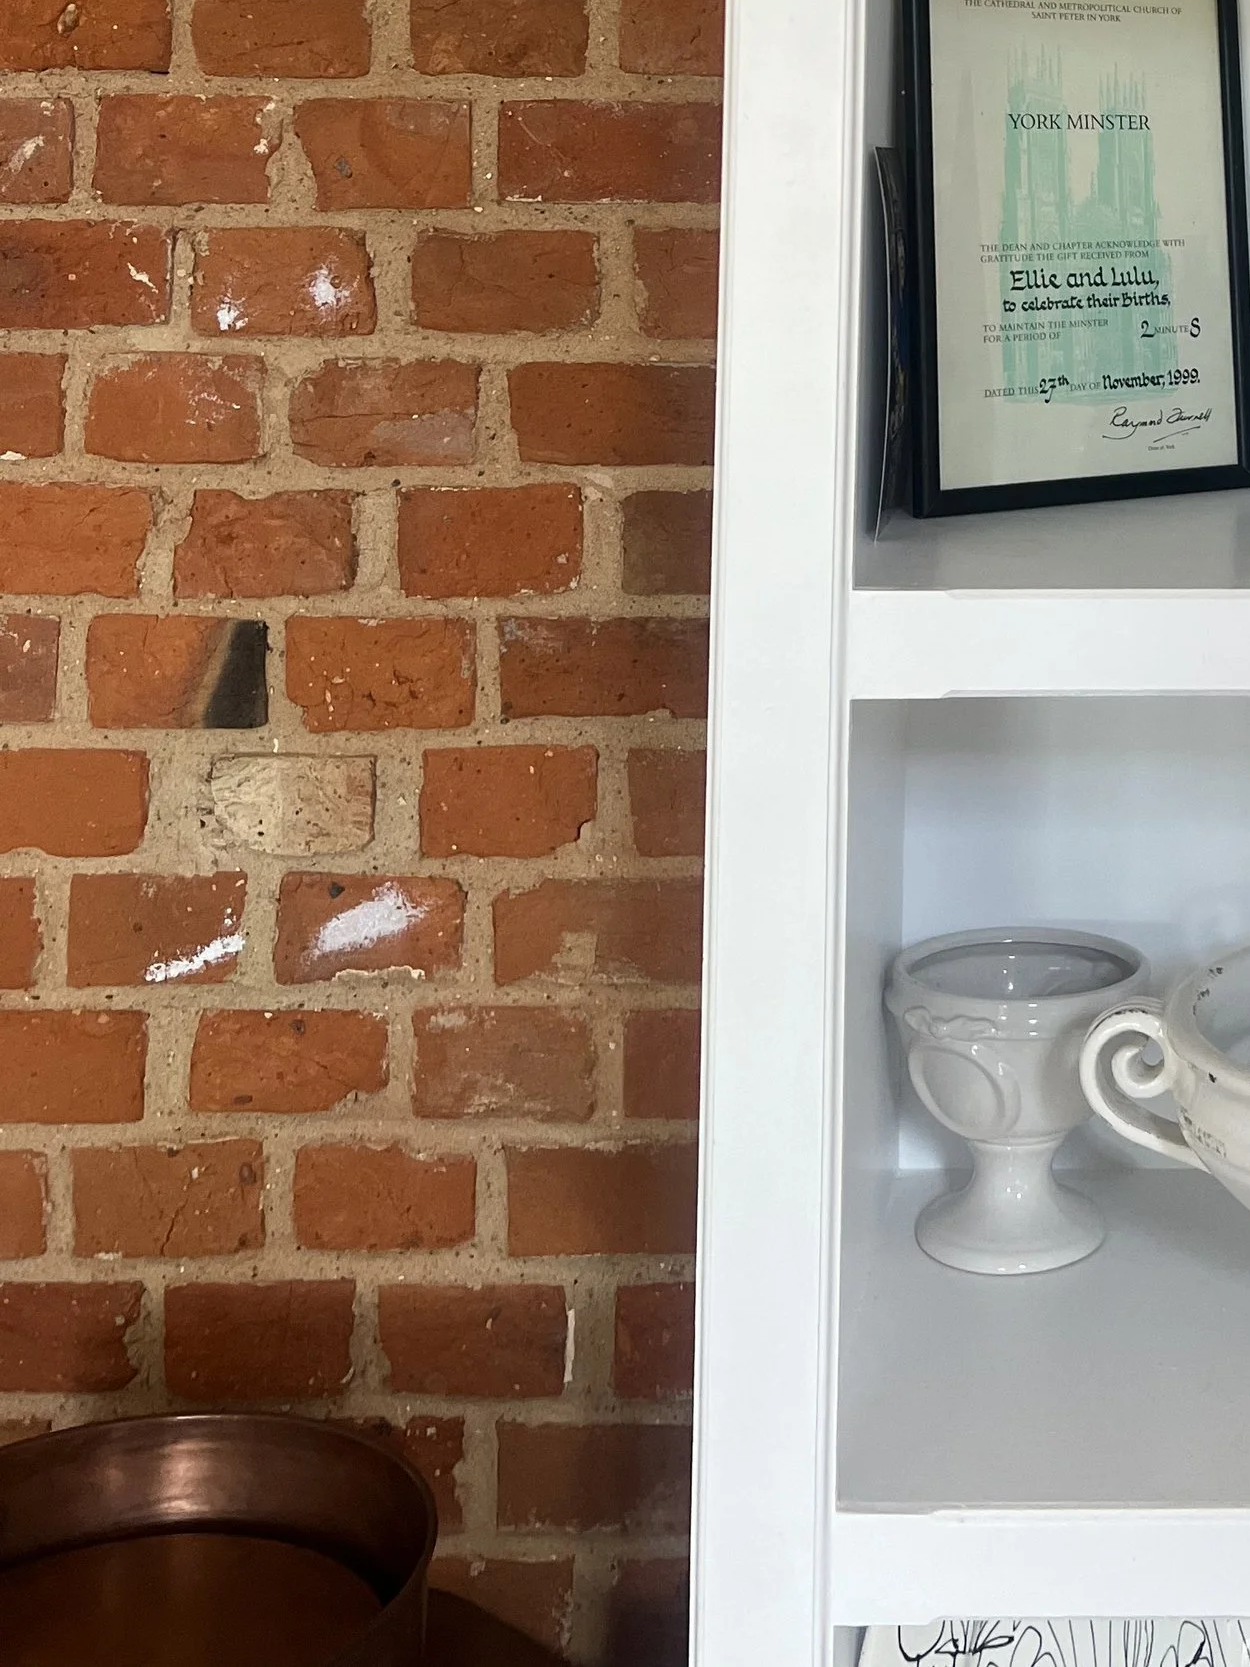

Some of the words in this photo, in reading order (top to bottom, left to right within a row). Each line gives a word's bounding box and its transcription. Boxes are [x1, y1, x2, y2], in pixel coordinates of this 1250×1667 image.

[984, 0, 1035, 9] CATHEDRAL
[1038, 1, 1057, 10] AND
[1059, 2, 1131, 13] METROPOLITICAL
[1133, 5, 1169, 15] CHURCH
[1171, 7, 1183, 15] OF
[1031, 11, 1057, 20] SAINT
[1059, 12, 1085, 21] PETER
[1098, 14, 1121, 22] YORK
[1008, 113, 1062, 130] YORK
[1067, 114, 1151, 131] MINSTER
[980, 244, 999, 253] THE
[1002, 243, 1028, 252] DEAN
[1029, 242, 1050, 251] AND
[1052, 241, 1093, 250] CHAPTER
[1094, 239, 1160, 249] ACKNOWLEDGE
[1162, 238, 1185, 247] WITH
[980, 253, 1034, 263] GRATITUDE
[1036, 253, 1054, 261] THE
[1056, 252, 1078, 261] GIFT
[1080, 251, 1122, 260] RECEIVED
[1124, 250, 1150, 259] FROM
[1009, 267, 1062, 291] Ellie
[1066, 266, 1109, 289] and
[1111, 265, 1160, 290] Lulu,
[1002, 298, 1017, 313] to
[1021, 295, 1084, 311] celebrate
[1086, 294, 1120, 309] their
[983, 324, 997, 333] TO
[999, 322, 1046, 332] MAINTAIN
[1048, 320, 1068, 329] THE
[1069, 319, 1109, 328] MINSTER
[983, 335, 1002, 343] FOR
[1004, 335, 1011, 343] A
[1013, 333, 1047, 342] PERIOD
[1049, 331, 1062, 340] OF
[984, 387, 1016, 398] DATED
[1018, 387, 1039, 396] THIS
[1039, 374, 1070, 403] 27th
[1070, 383, 1087, 392] DAY
[1089, 382, 1101, 390] OF
[1102, 372, 1165, 390] November,
[1167, 368, 1200, 386] 1999.
